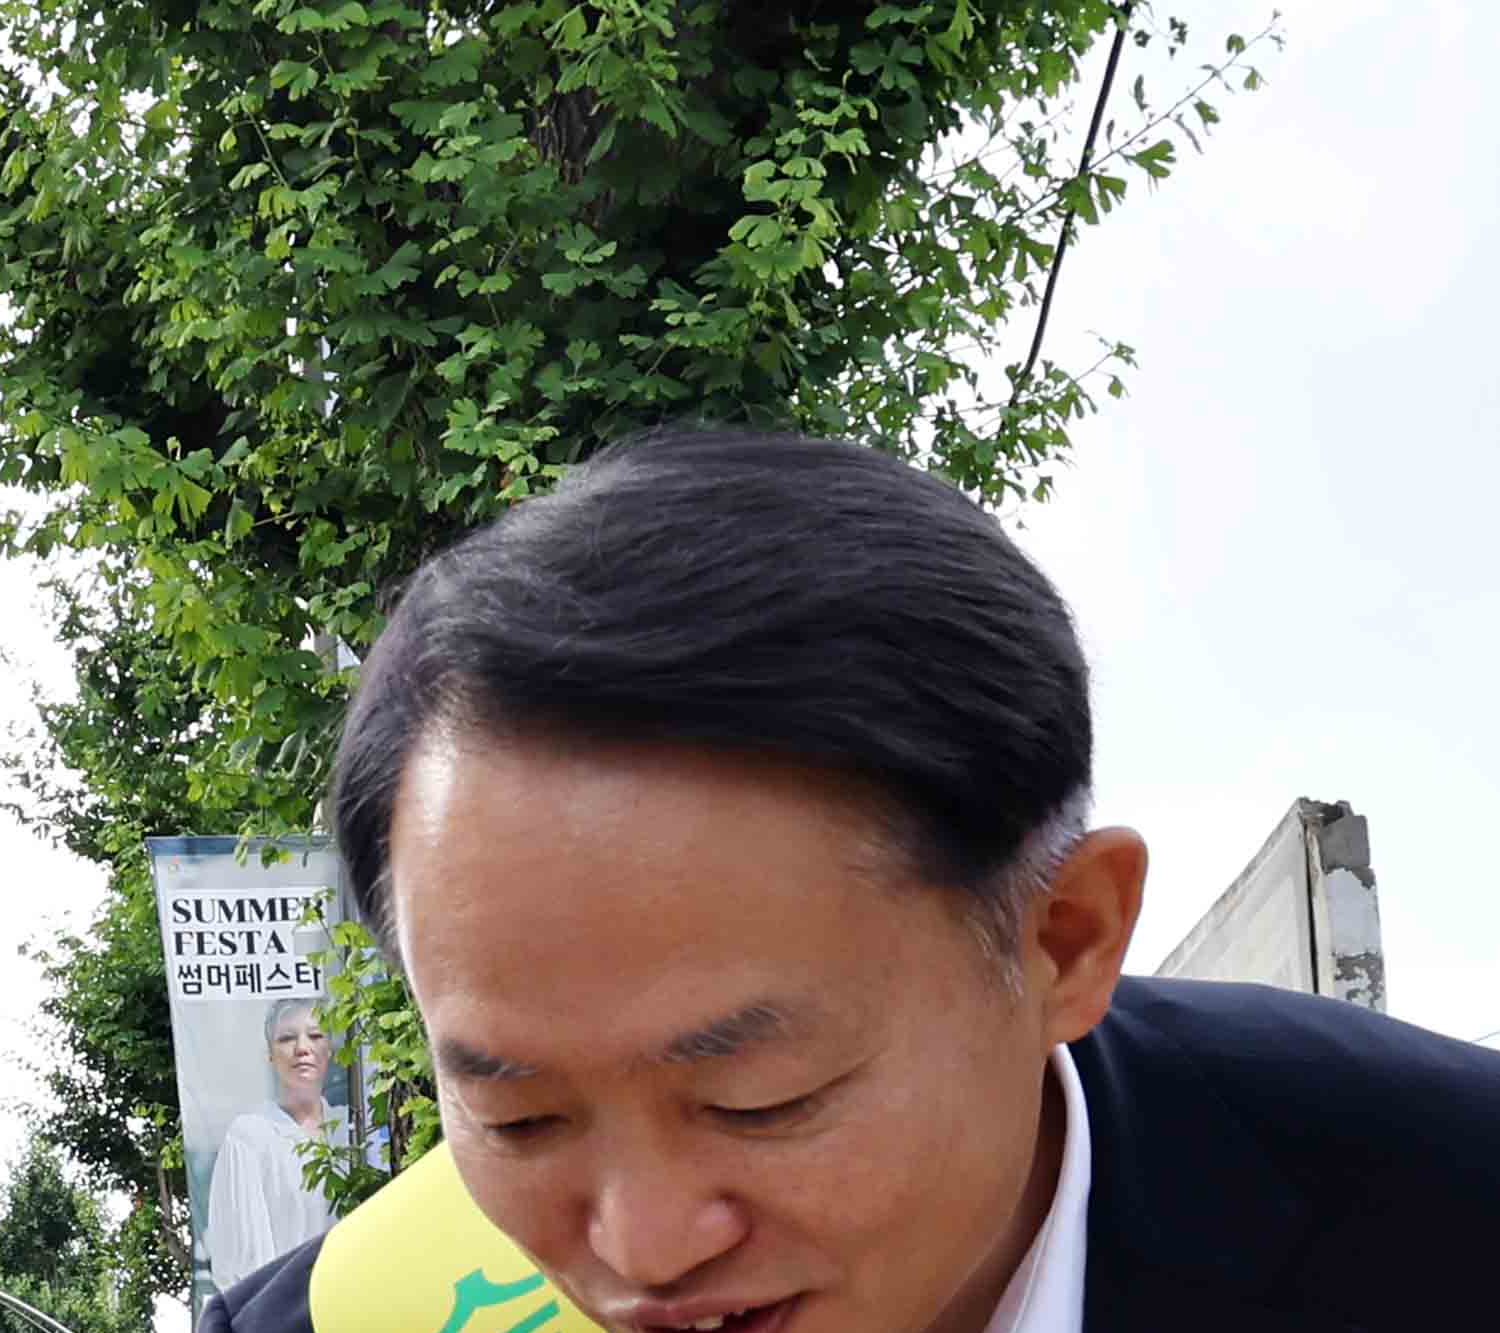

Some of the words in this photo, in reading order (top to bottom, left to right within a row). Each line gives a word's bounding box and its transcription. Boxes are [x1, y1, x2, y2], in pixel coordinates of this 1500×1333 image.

[172, 896, 325, 924] SUMMER
[174, 931, 287, 957] FESTA
[176, 963, 323, 996] 썸머페스타
